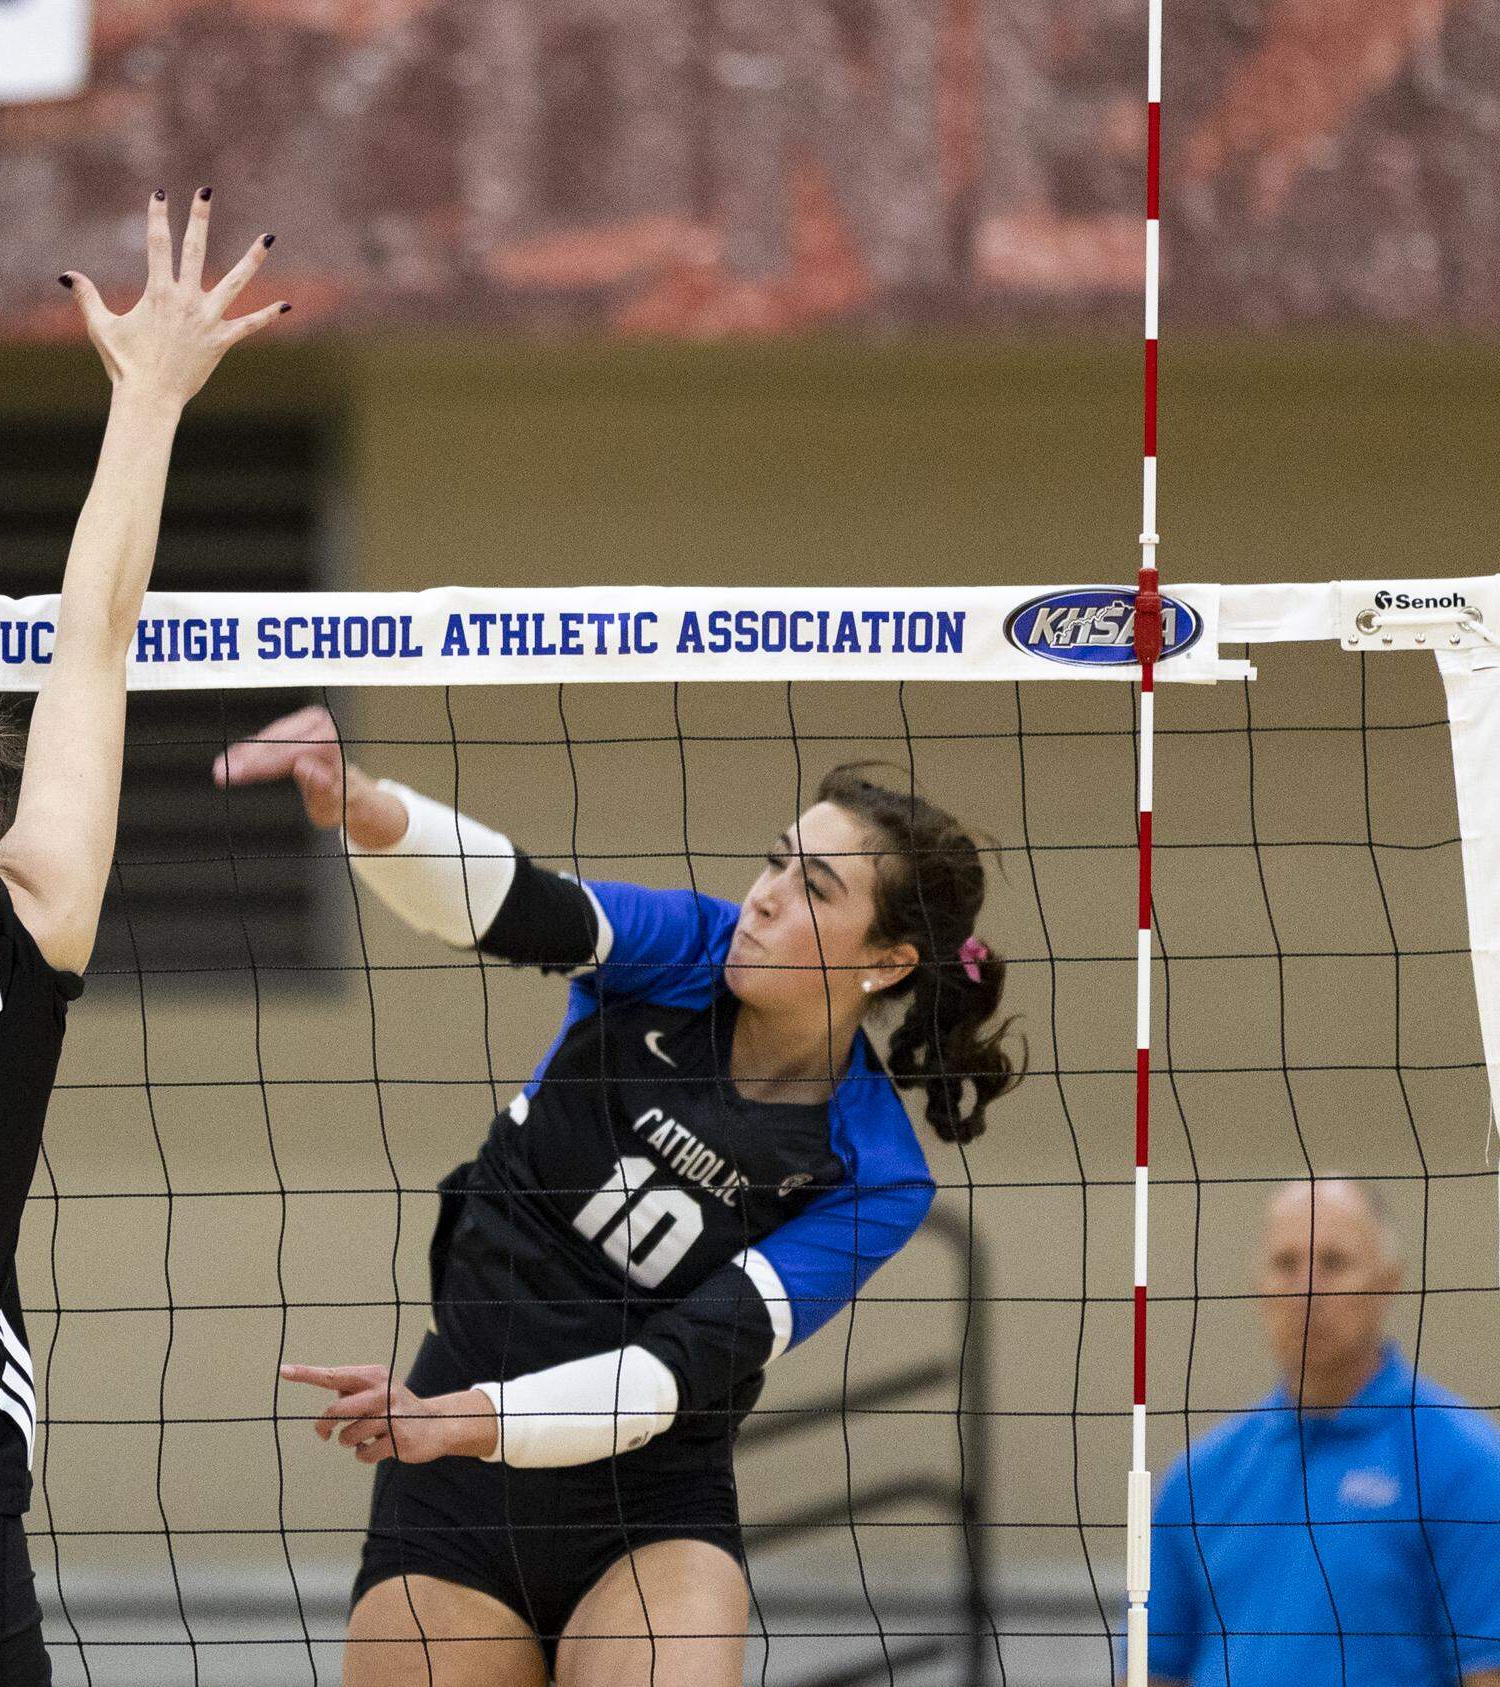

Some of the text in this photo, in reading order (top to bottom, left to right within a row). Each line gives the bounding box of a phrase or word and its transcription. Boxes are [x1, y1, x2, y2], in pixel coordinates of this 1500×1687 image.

[135, 617, 240, 662] HIGH
[257, 614, 422, 660] SCHOOL
[441, 611, 658, 657] ATHLETIC
[676, 610, 964, 655] ASSOCIATION
[1395, 592, 1466, 610] Senoh
[632, 1106, 750, 1208] CATHOLIC
[572, 1155, 705, 1290] 10
